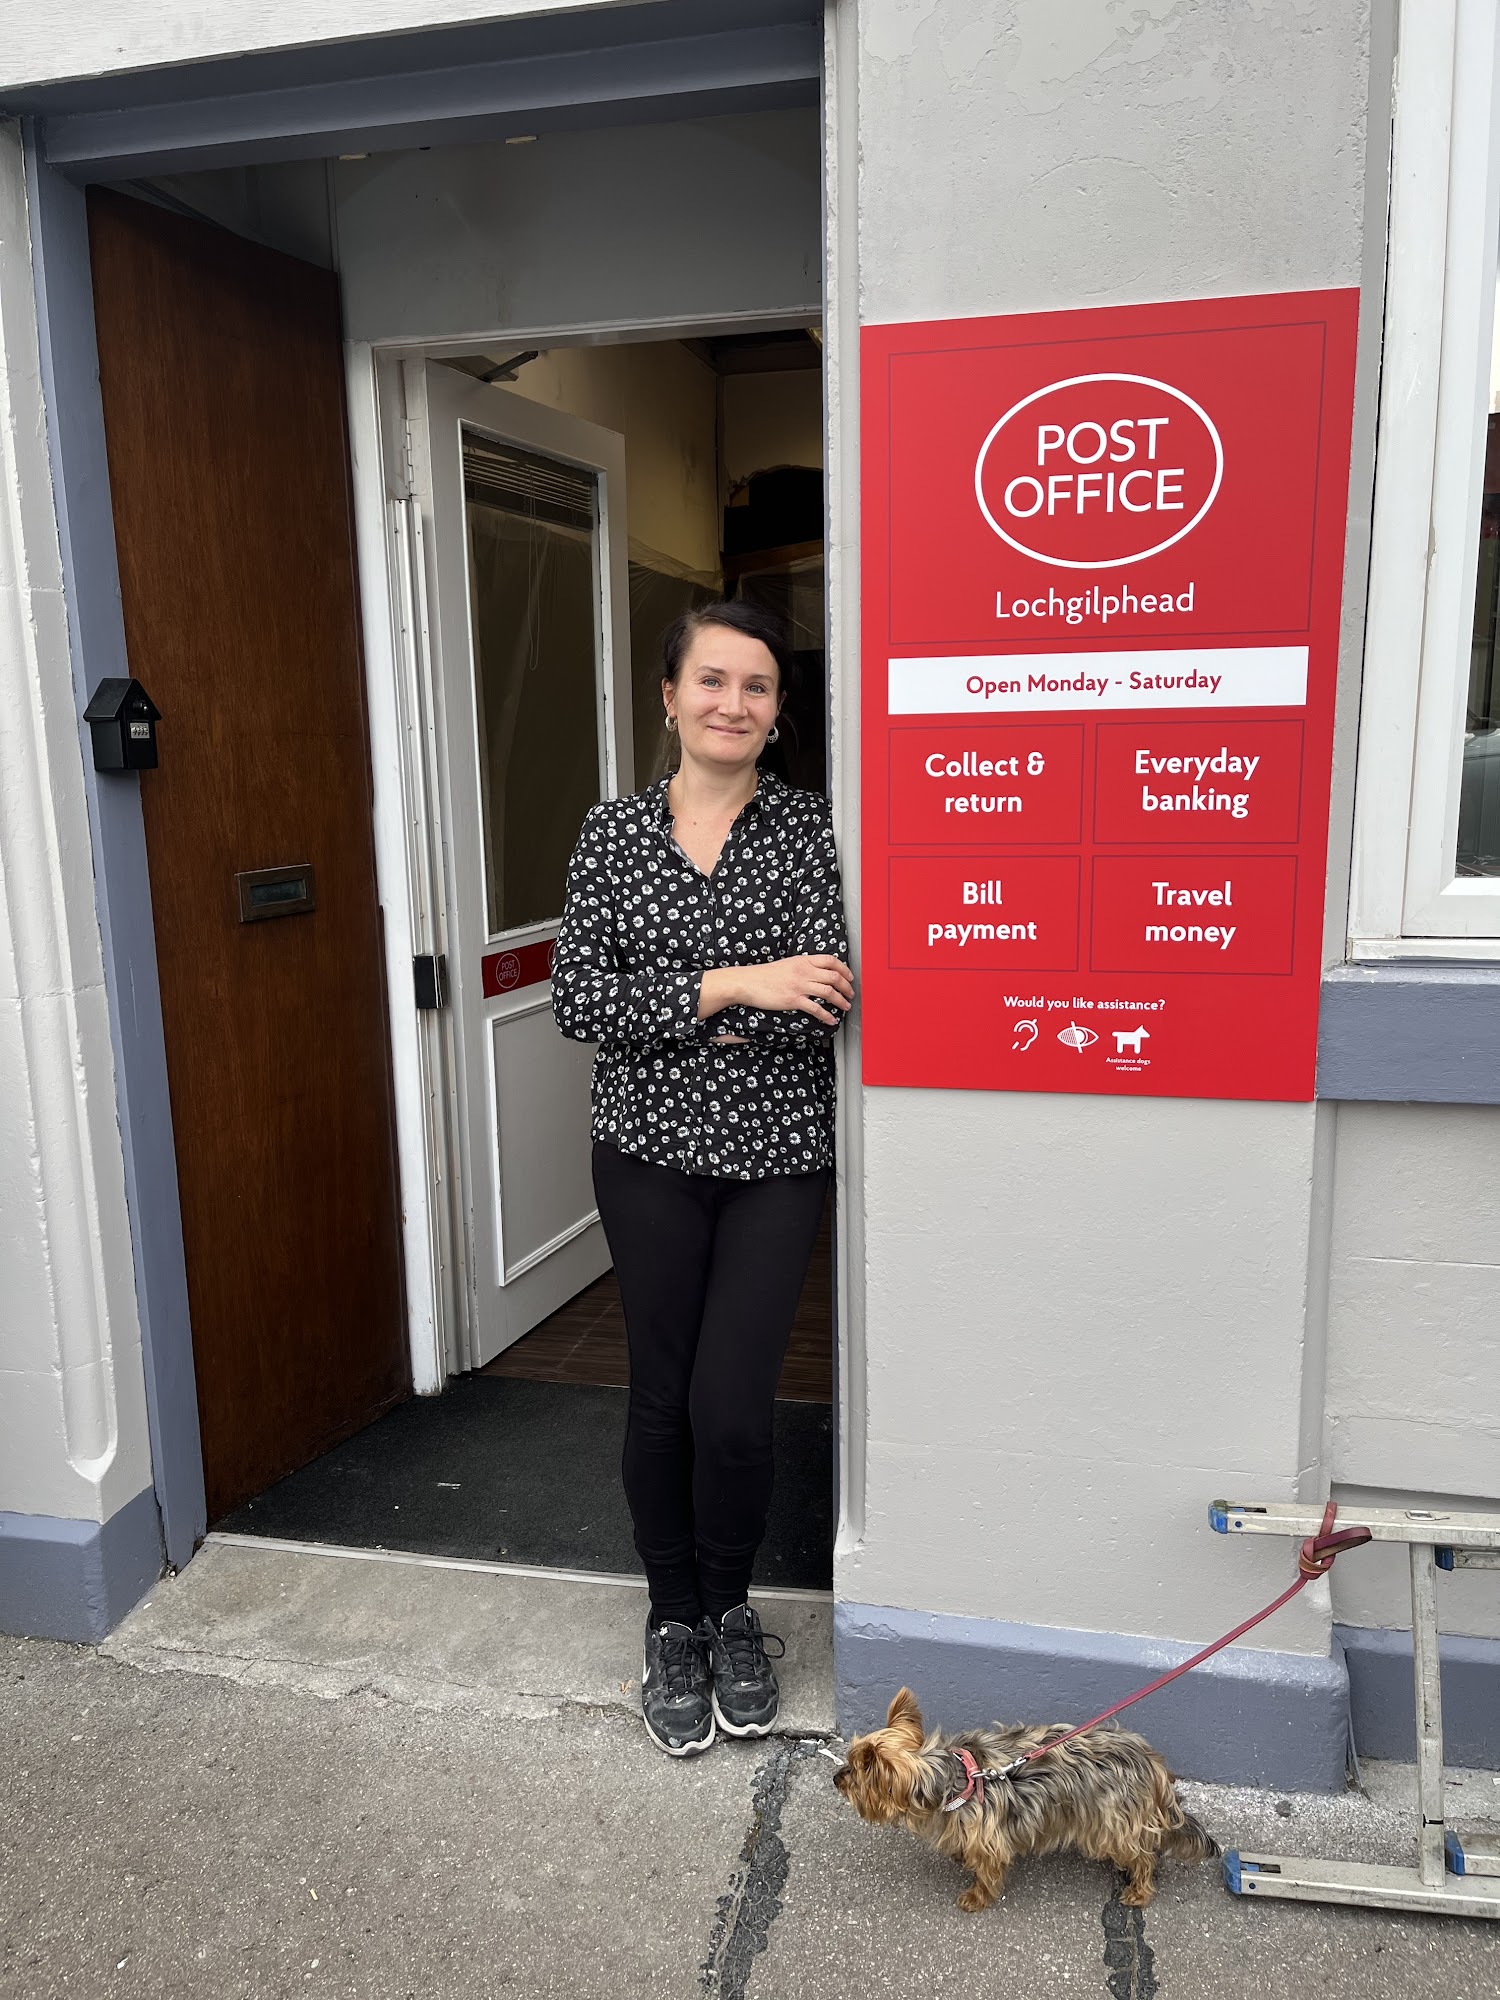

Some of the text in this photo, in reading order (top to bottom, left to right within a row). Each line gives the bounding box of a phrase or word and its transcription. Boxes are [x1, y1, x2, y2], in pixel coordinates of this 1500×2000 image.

[1037, 417, 1169, 466] POST
[1004, 468, 1185, 518] OFFICE
[995, 581, 1195, 625] Lochgilphead
[966, 675, 1021, 700] Open
[1027, 671, 1109, 697] Monday
[1129, 668, 1223, 694] Saturday
[924, 751, 1046, 778] Collect &
[1135, 747, 1261, 781] Everyday
[944, 793, 1023, 814] return
[1141, 786, 1250, 819] banking
[962, 879, 1003, 905] Bill
[1151, 880, 1233, 907] Travel
[927, 921, 1038, 947] payment
[1145, 925, 1237, 950] money
[499, 968, 518, 981] OFFICE
[501, 960, 515, 971] POST
[1003, 995, 1166, 1012] Would you like assistance?
[1105, 1056, 1151, 1066] Assistance dogs
[1115, 1064, 1142, 1072] welcome
